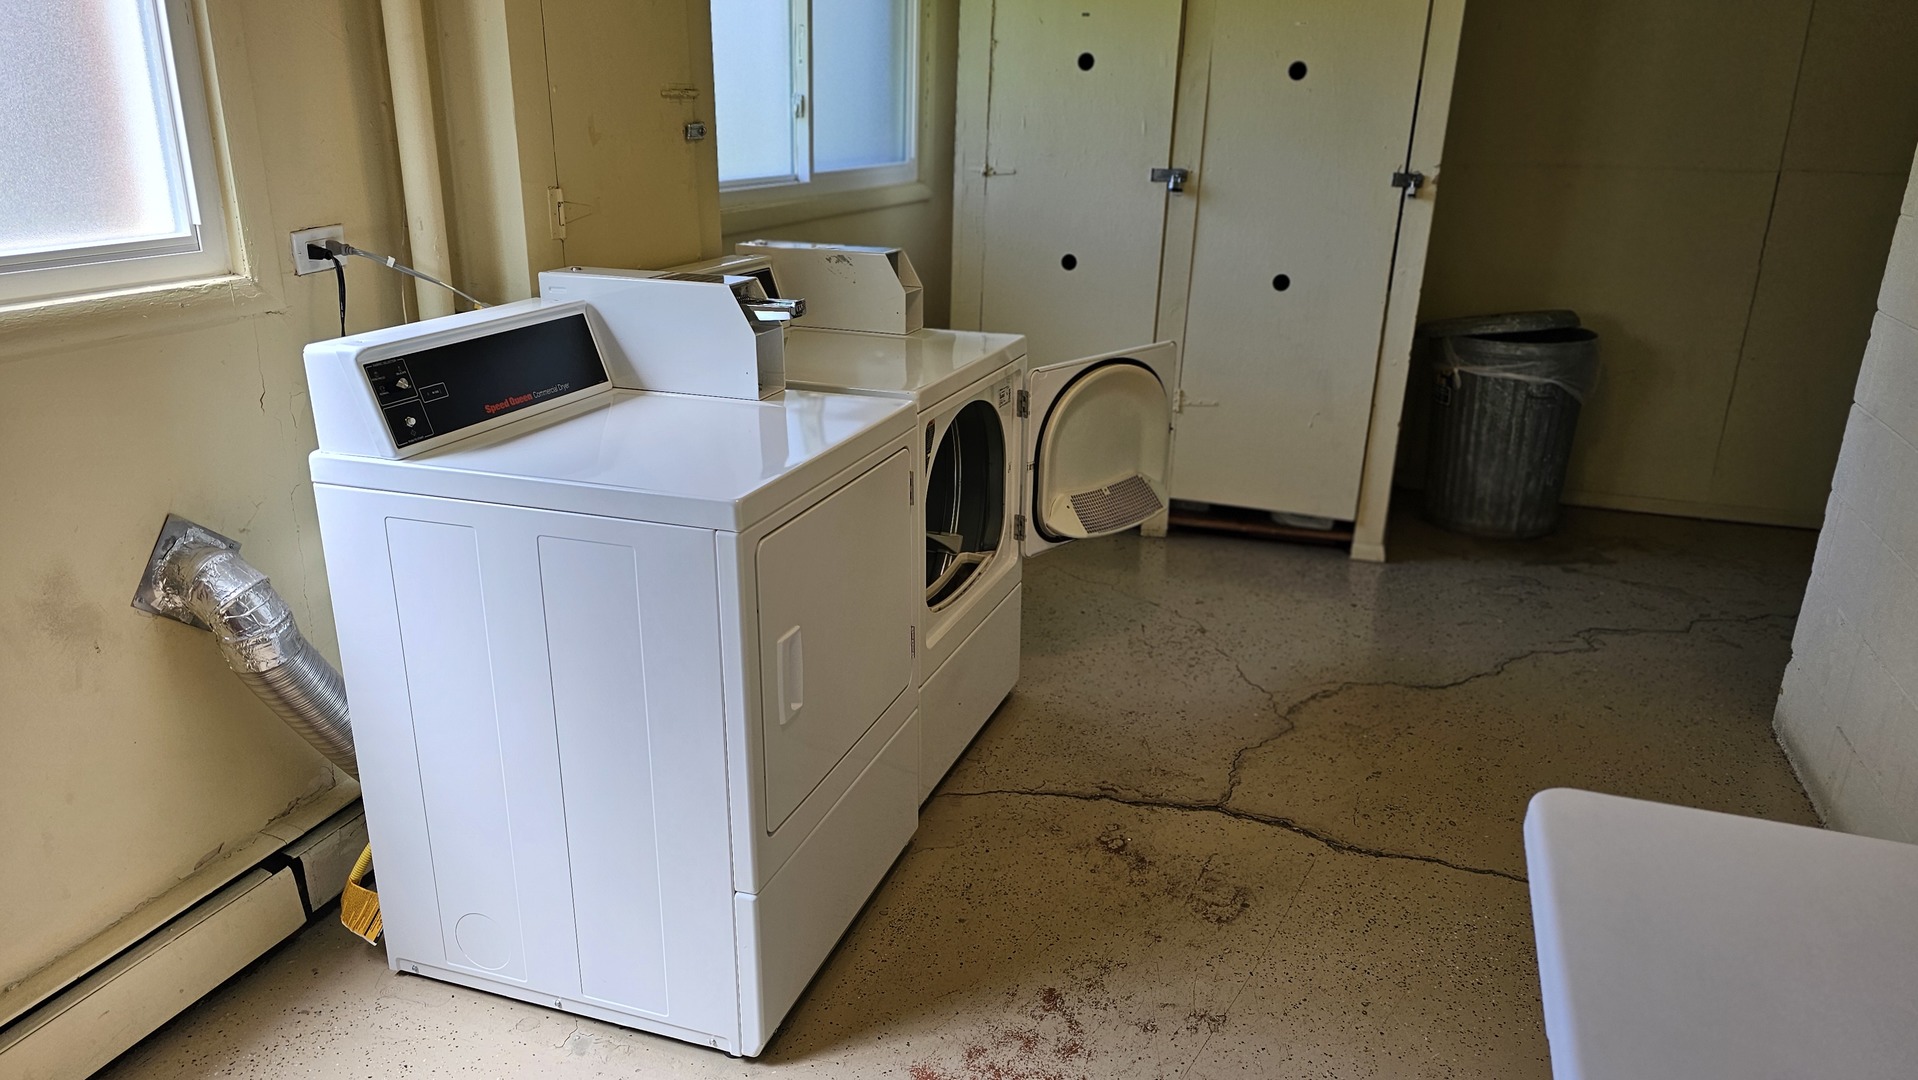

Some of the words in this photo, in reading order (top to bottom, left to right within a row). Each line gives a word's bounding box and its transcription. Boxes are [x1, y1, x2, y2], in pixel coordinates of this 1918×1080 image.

[485, 398, 510, 414] Speed
[509, 393, 533, 407] Queen
[533, 386, 558, 399] Commercial
[557, 382, 570, 392] Dryer
